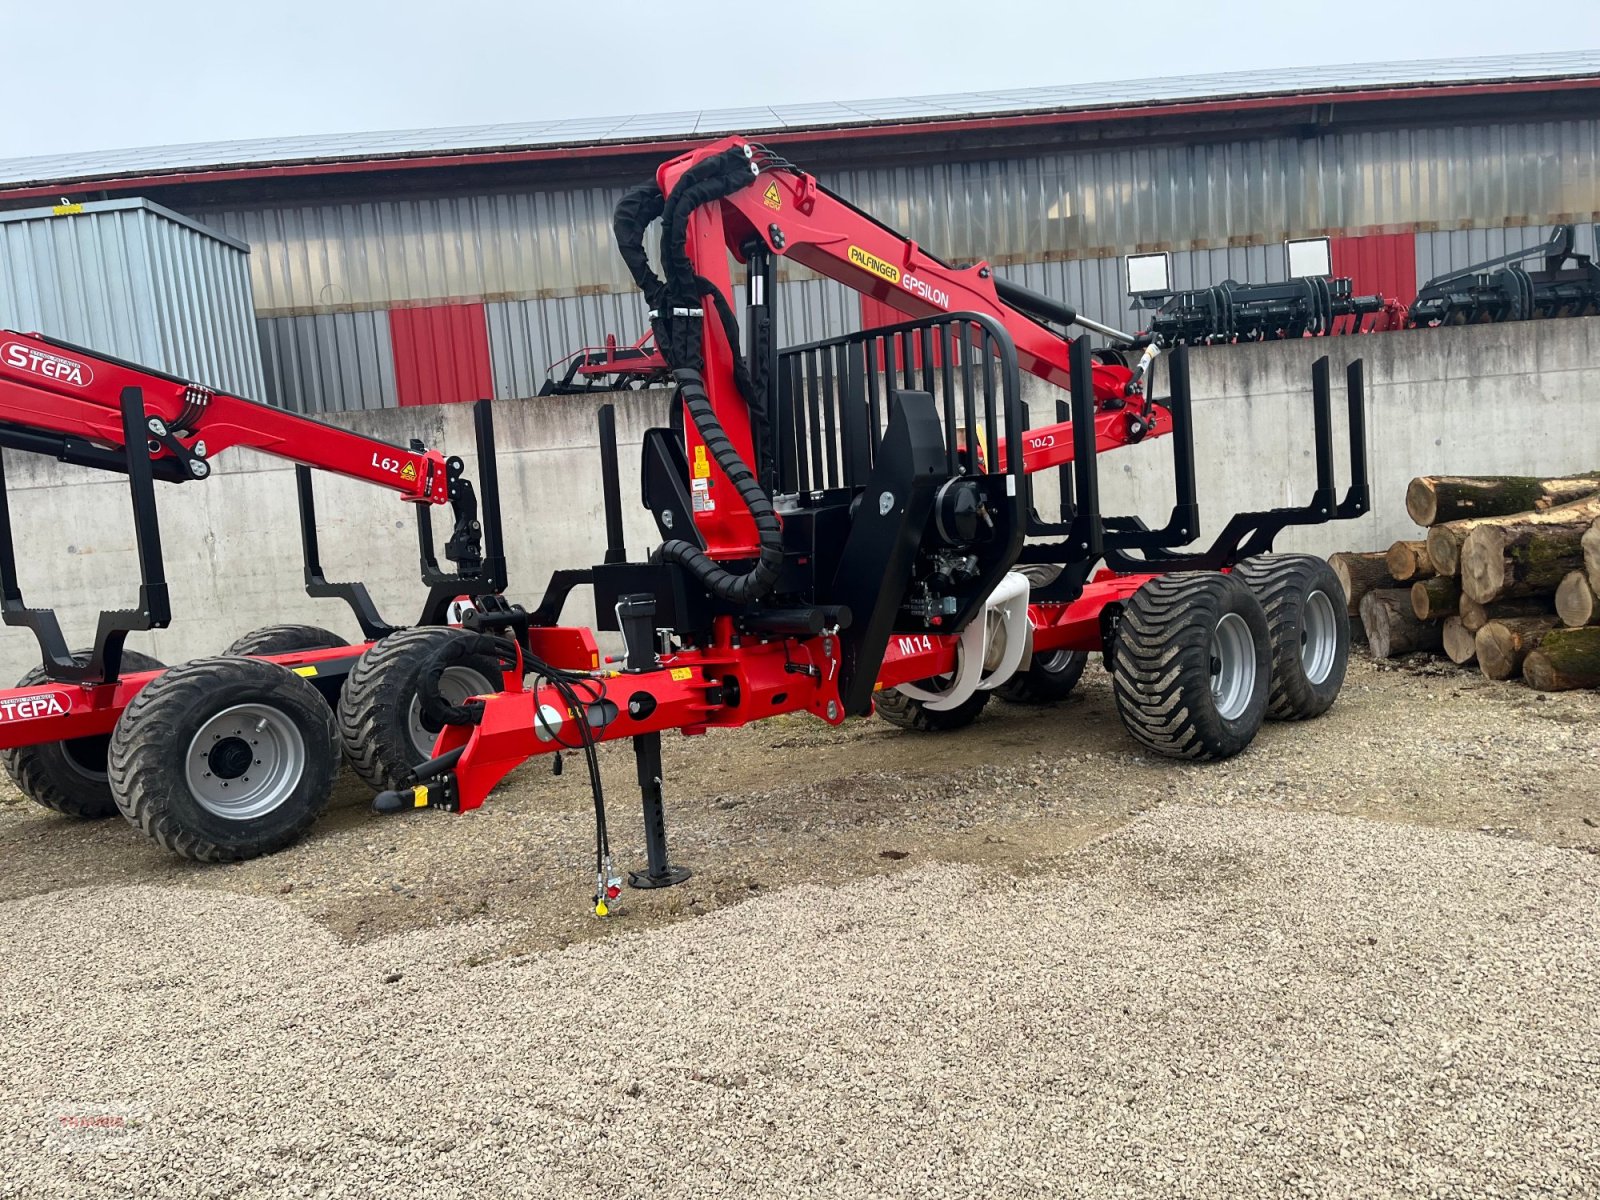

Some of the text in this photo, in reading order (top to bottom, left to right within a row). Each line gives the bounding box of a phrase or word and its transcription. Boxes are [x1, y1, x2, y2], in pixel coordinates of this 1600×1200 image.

[851, 248, 949, 308] PALFINGER EPSILON
[7, 344, 83, 385] STEPA
[1029, 435, 1055, 449] C70L
[371, 452, 399, 474] L62
[898, 634, 932, 656] M14
[0, 698, 65, 720] TEPA
